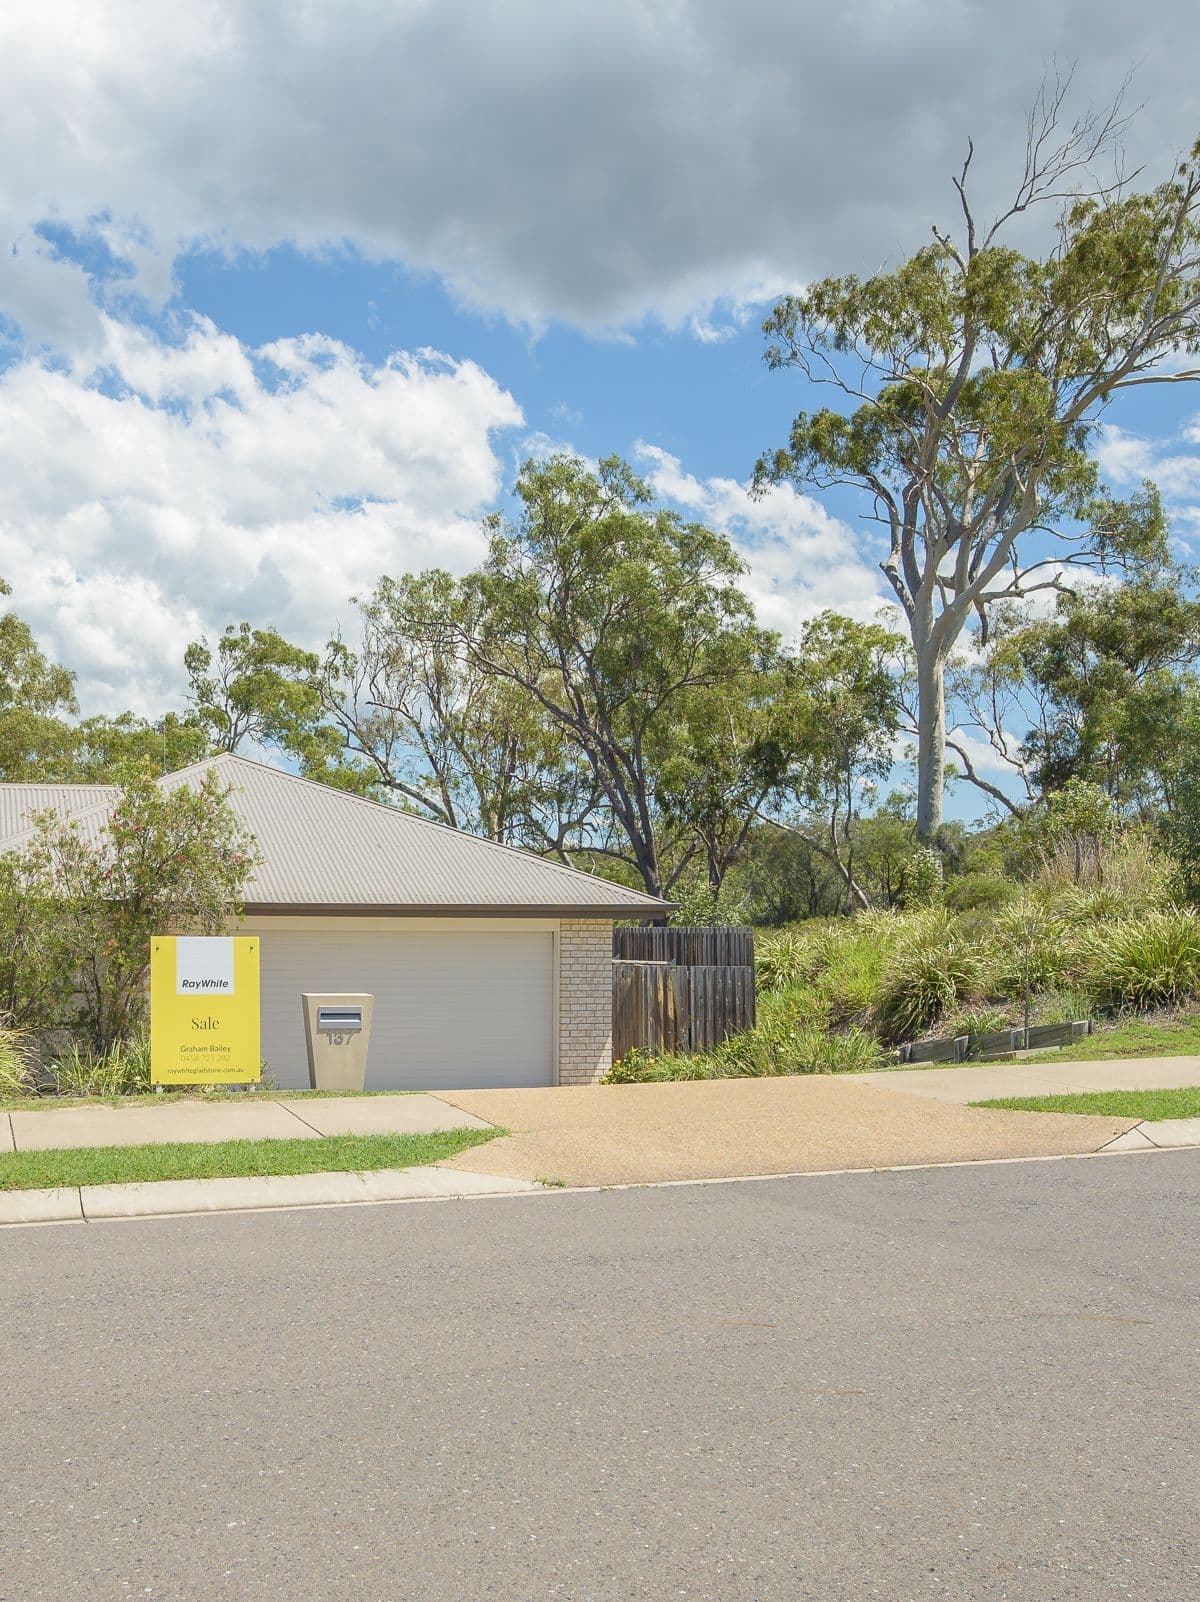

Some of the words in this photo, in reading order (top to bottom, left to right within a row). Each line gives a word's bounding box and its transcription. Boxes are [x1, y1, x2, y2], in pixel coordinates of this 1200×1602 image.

[182, 979, 229, 990] RayWhite
[191, 1017, 220, 1030] Sale
[180, 1045, 208, 1053] Graham
[209, 1045, 232, 1054] Bailey
[167, 1067, 244, 1075] raywhitegladstone.com.au
